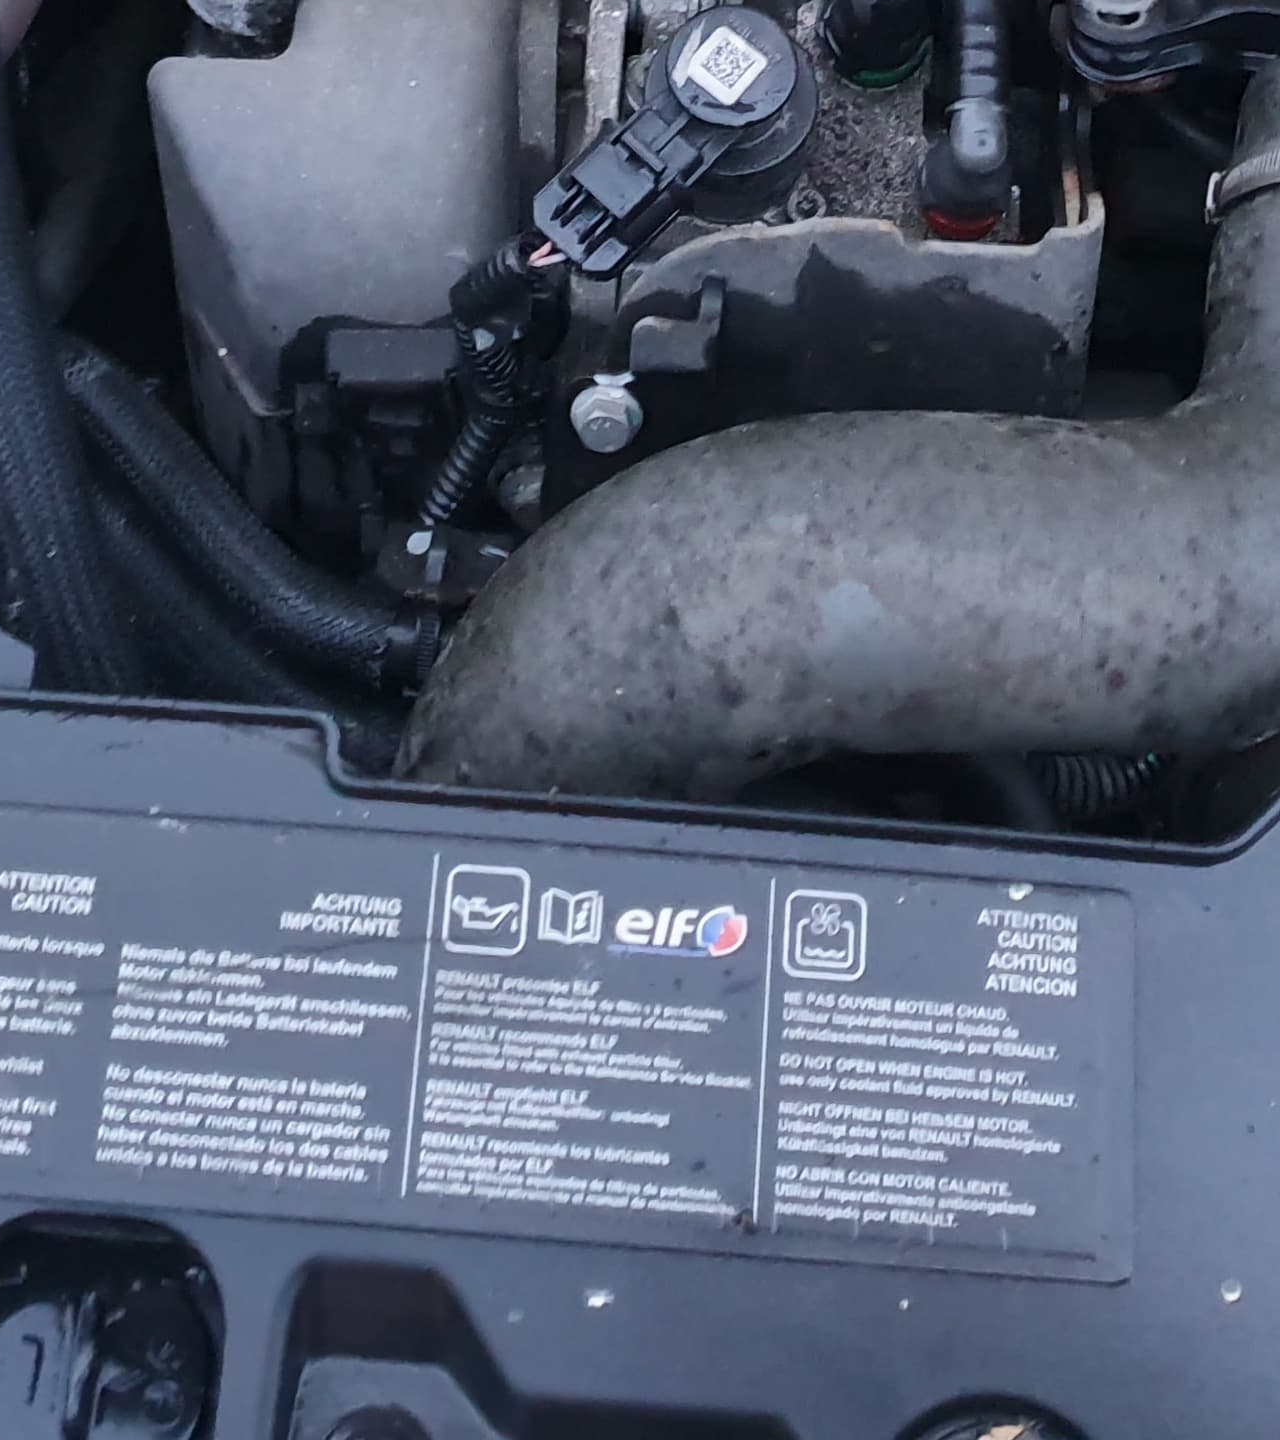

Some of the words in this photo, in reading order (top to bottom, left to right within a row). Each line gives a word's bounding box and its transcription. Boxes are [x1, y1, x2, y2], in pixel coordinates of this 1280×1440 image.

[10, 891, 93, 916] CAUTION
[312, 892, 402, 916] ACHTUNG
[280, 910, 400, 938] IMPORTANTE
[613, 903, 700, 948] elf
[976, 909, 1078, 933] ATTENTION
[997, 930, 1077, 953] CAUTION
[986, 951, 1076, 974] ACHTUNG
[984, 972, 1076, 997] ATENCION
[806, 992, 835, 1007] PAS
[894, 999, 953, 1016] MOTEUR
[106, 1064, 129, 1081] No
[779, 1054, 800, 1068] DO
[804, 1055, 832, 1071] NOT
[835, 1058, 875, 1074] OPEN
[878, 1061, 920, 1078] WHEN
[923, 1065, 975, 1082] ENGINE
[185, 1090, 235, 1109] motor
[102, 1104, 126, 1121] No
[775, 1164, 797, 1179] NO
[882, 1173, 935, 1190] MOTOR
